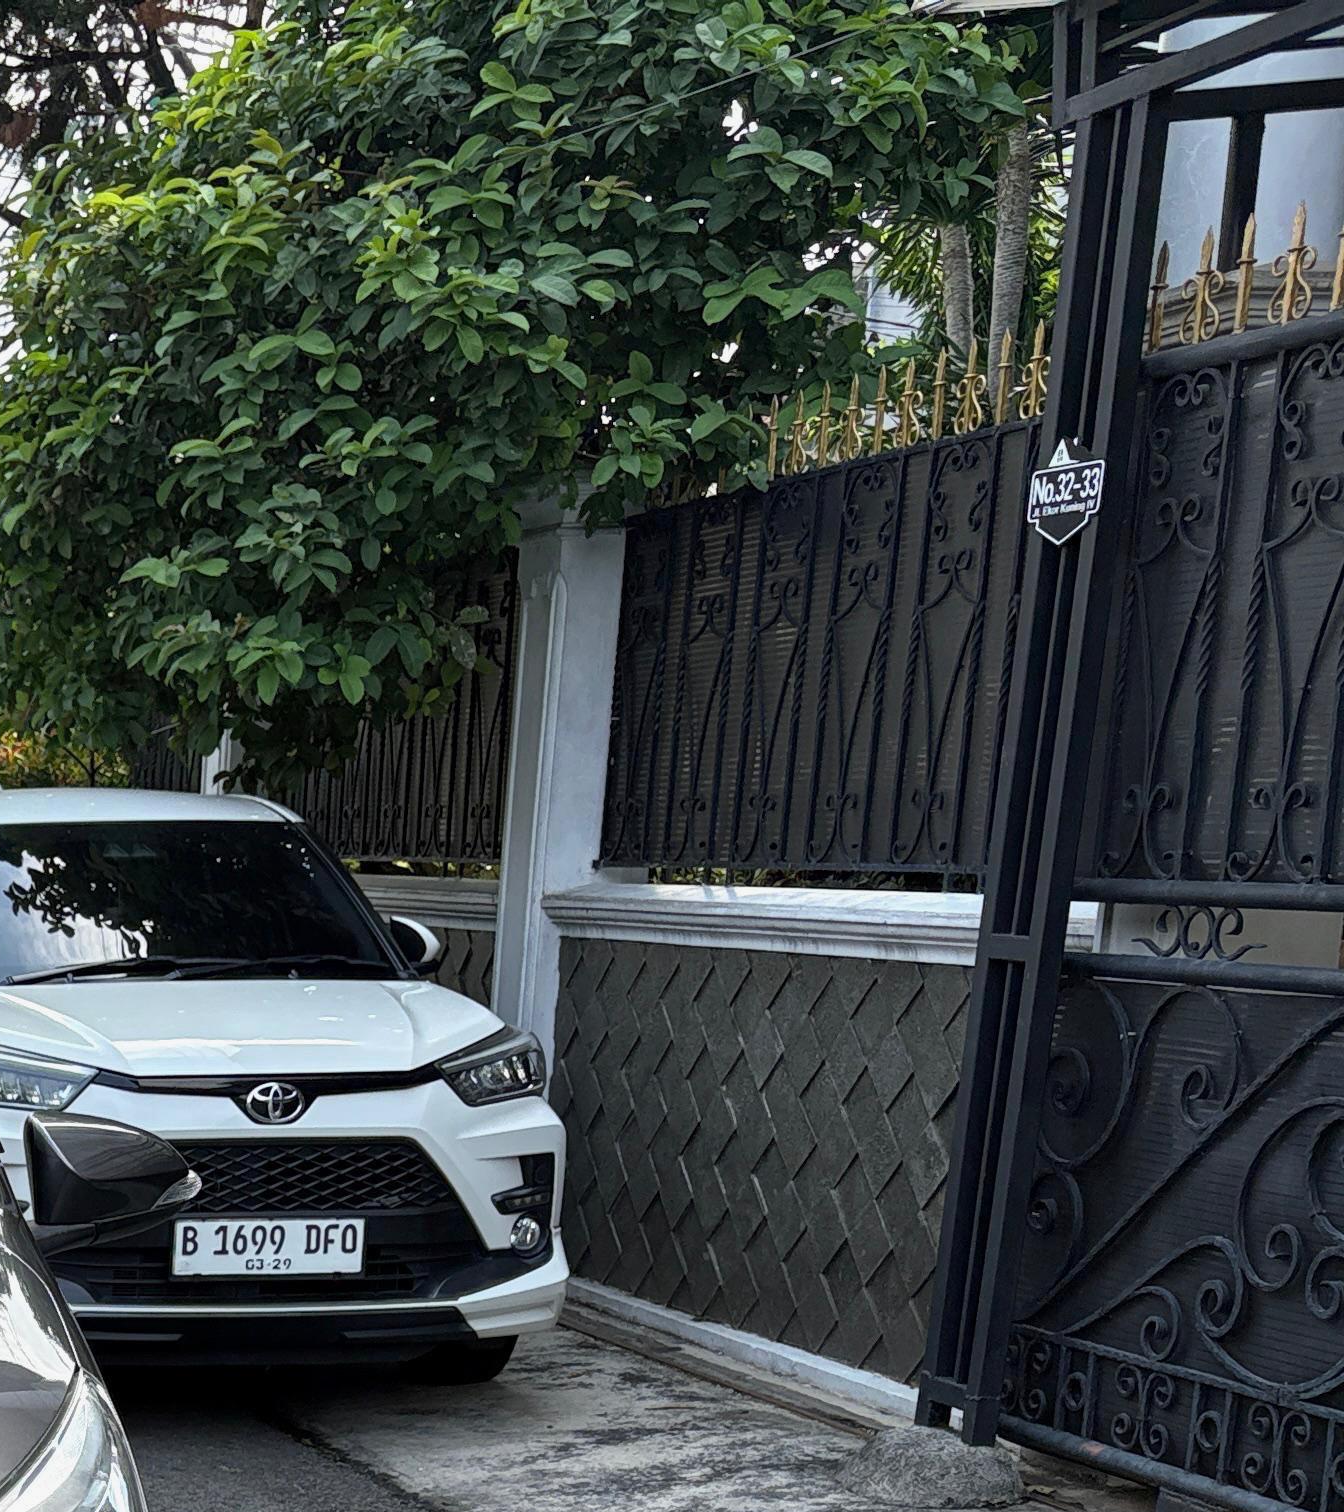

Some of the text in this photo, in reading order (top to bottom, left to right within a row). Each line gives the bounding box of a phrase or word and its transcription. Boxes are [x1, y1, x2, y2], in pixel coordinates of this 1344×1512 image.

[1032, 467, 1100, 506] No.32-33
[181, 1223, 358, 1256] B 1699 DFO
